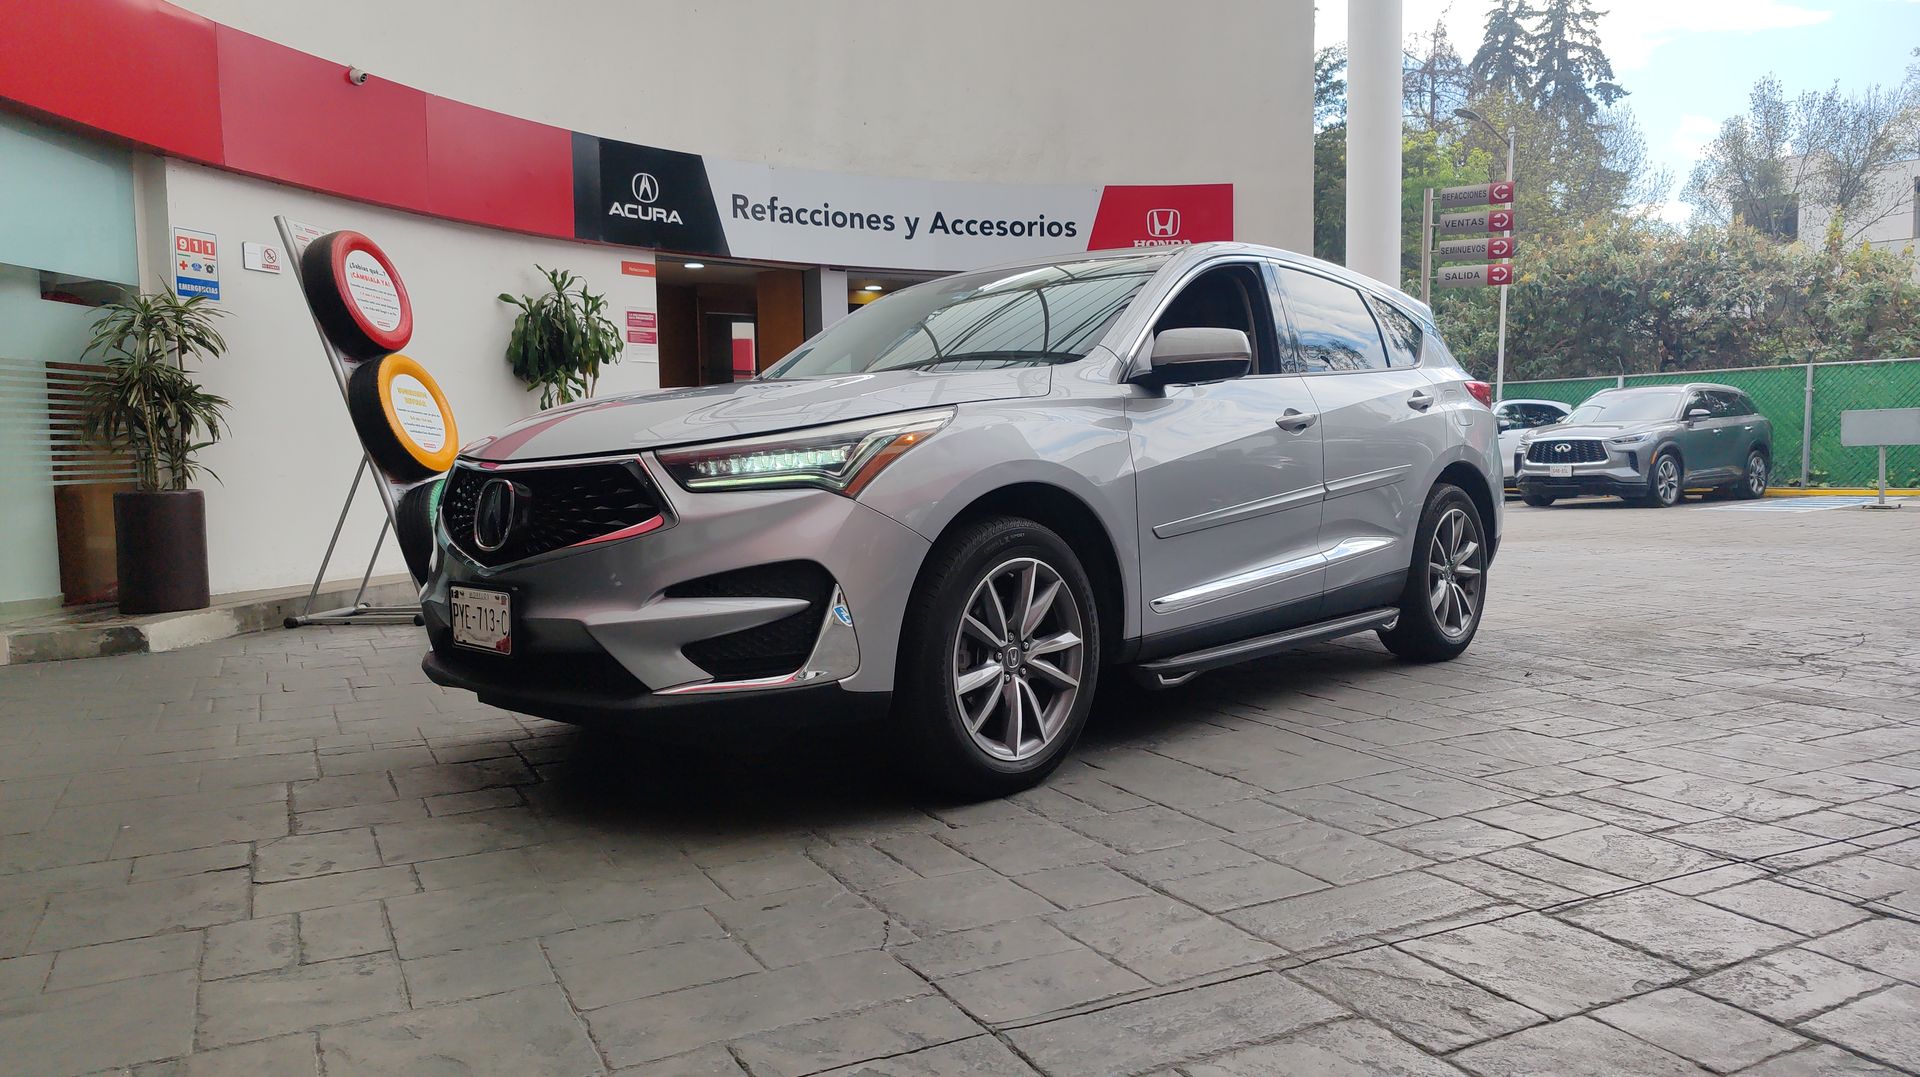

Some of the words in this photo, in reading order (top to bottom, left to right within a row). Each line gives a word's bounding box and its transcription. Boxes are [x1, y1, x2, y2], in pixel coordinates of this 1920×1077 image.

[1442, 190, 1487, 201] REFACCIONES
[608, 202, 683, 225] ACURA
[732, 194, 895, 231] Refacciones
[904, 216, 920, 240] y
[929, 211, 1077, 238] Accesorios
[1444, 218, 1485, 228] VENTAS
[179, 238, 213, 254] 911
[1440, 245, 1486, 255] SEMINUEVOS
[1444, 271, 1480, 280] SALIDA
[453, 603, 507, 635] PYE-713-C
